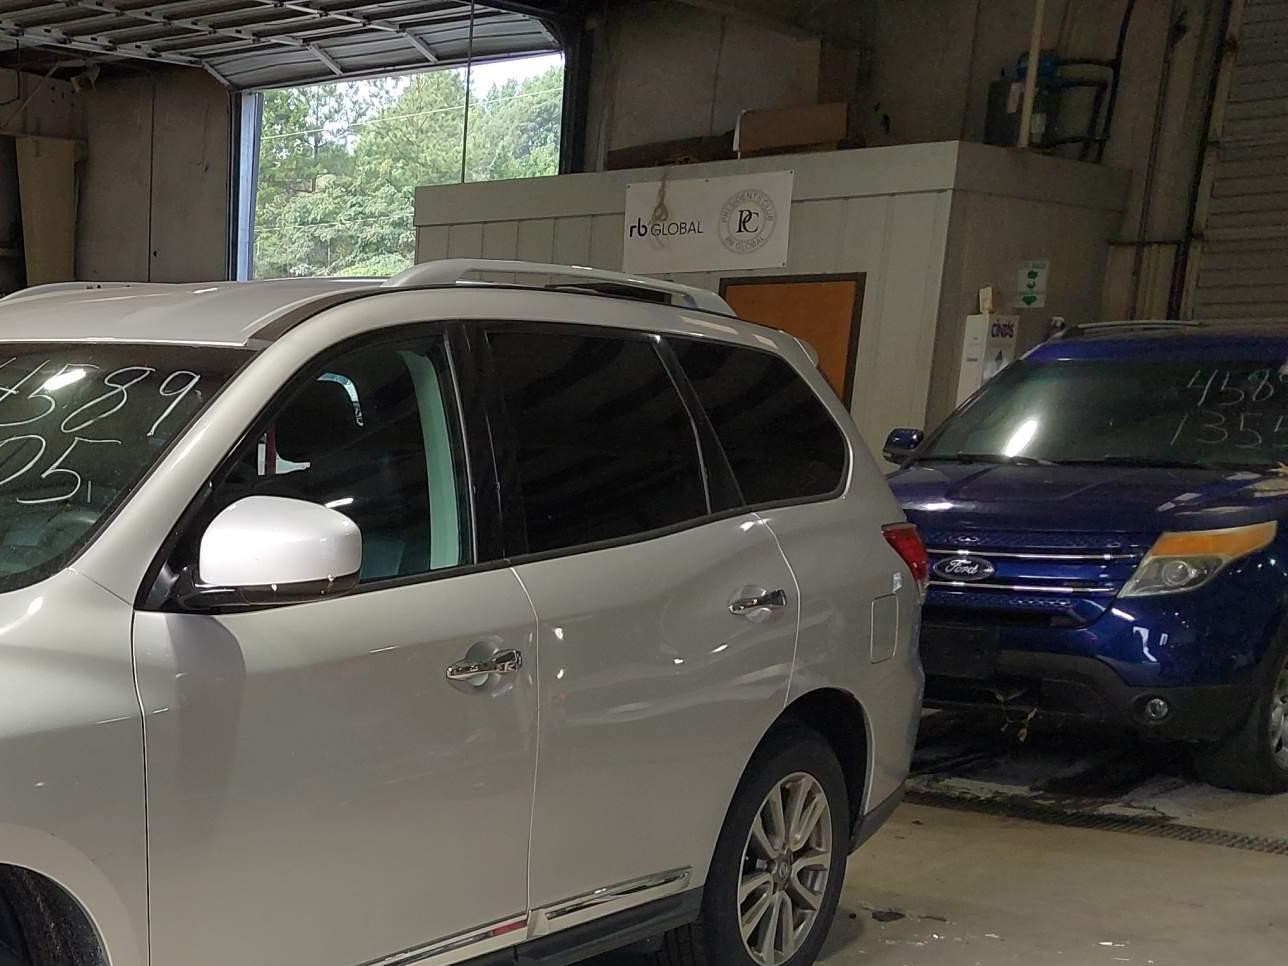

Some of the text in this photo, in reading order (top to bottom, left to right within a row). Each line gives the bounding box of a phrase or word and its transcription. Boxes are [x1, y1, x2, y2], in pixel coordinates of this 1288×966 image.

[629, 217, 704, 238] rb GLOBAL
[944, 559, 980, 574] Ford
